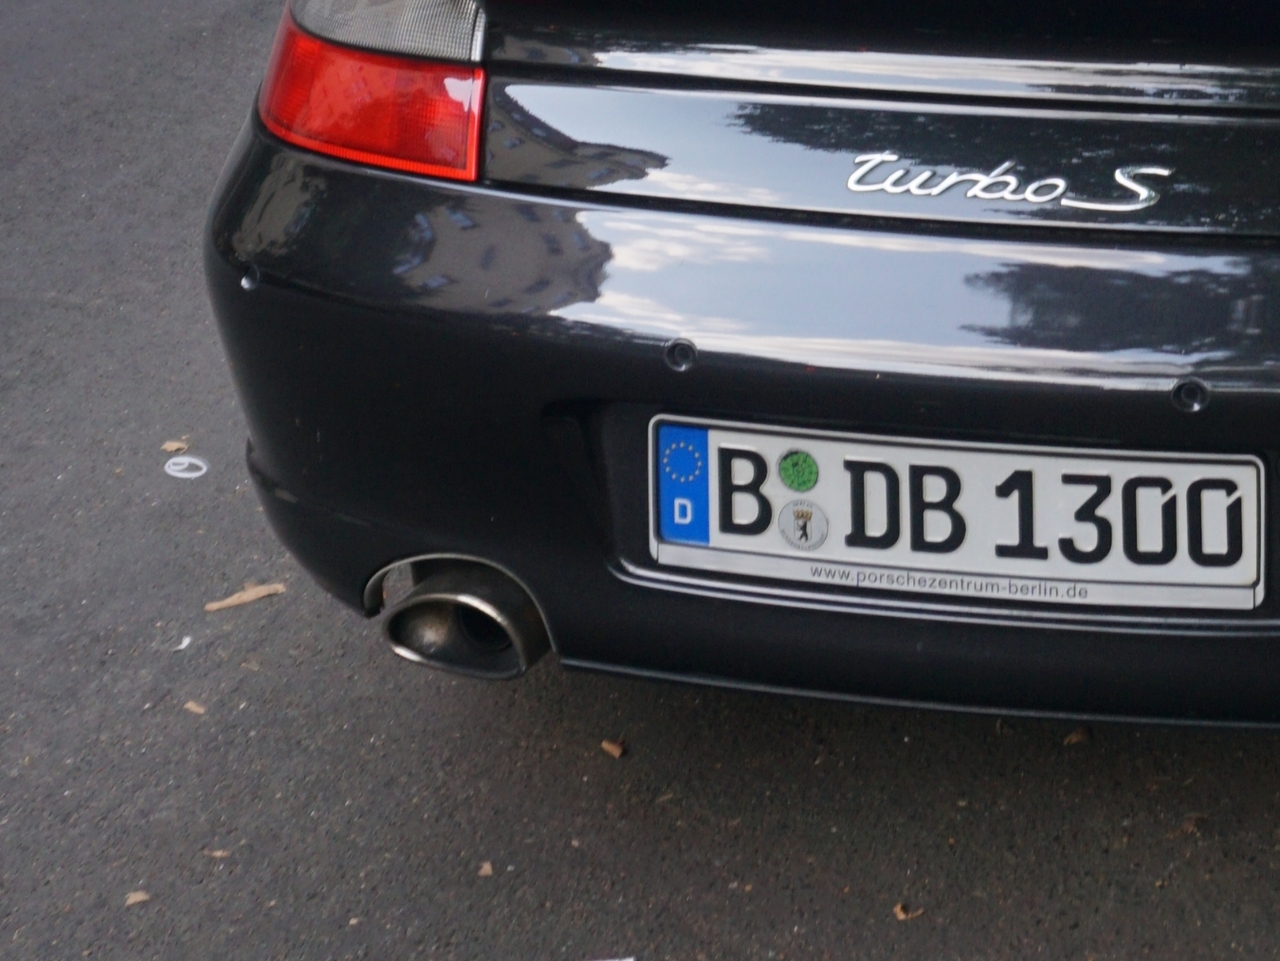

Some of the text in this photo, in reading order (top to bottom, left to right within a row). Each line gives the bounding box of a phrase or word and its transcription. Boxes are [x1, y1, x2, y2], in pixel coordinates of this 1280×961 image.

[847, 150, 1175, 212] turbo S
[673, 497, 693, 525] D
[717, 446, 1244, 567] B DB 1300
[809, 564, 1089, 600] www.porschezentrum-berlin.de
